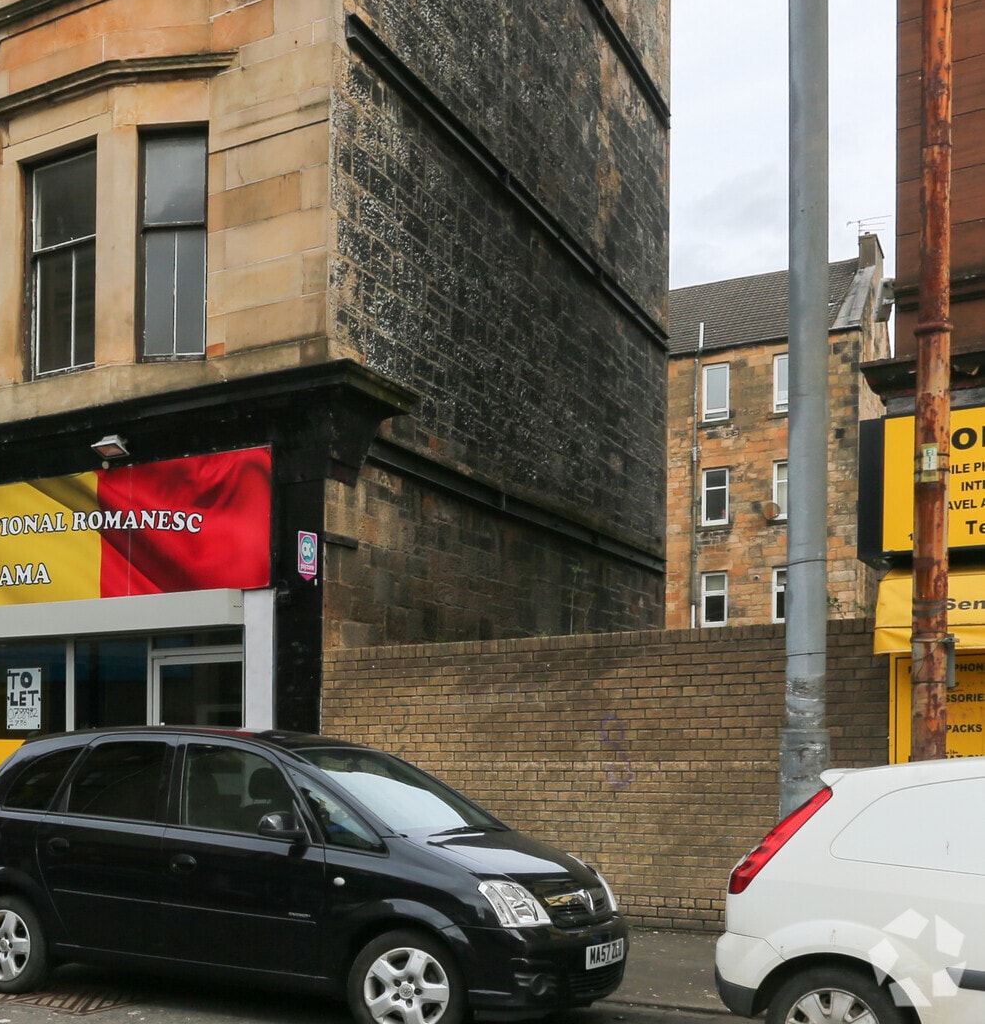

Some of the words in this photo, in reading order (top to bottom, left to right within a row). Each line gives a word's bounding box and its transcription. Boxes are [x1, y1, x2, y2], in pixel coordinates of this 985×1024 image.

[949, 463, 970, 474] ILE
[948, 499, 977, 510] AVEL
[72, 509, 204, 533] ROMANESC
[7, 671, 33, 690] TO
[10, 690, 39, 706] LET
[590, 944, 611, 965] MA57
